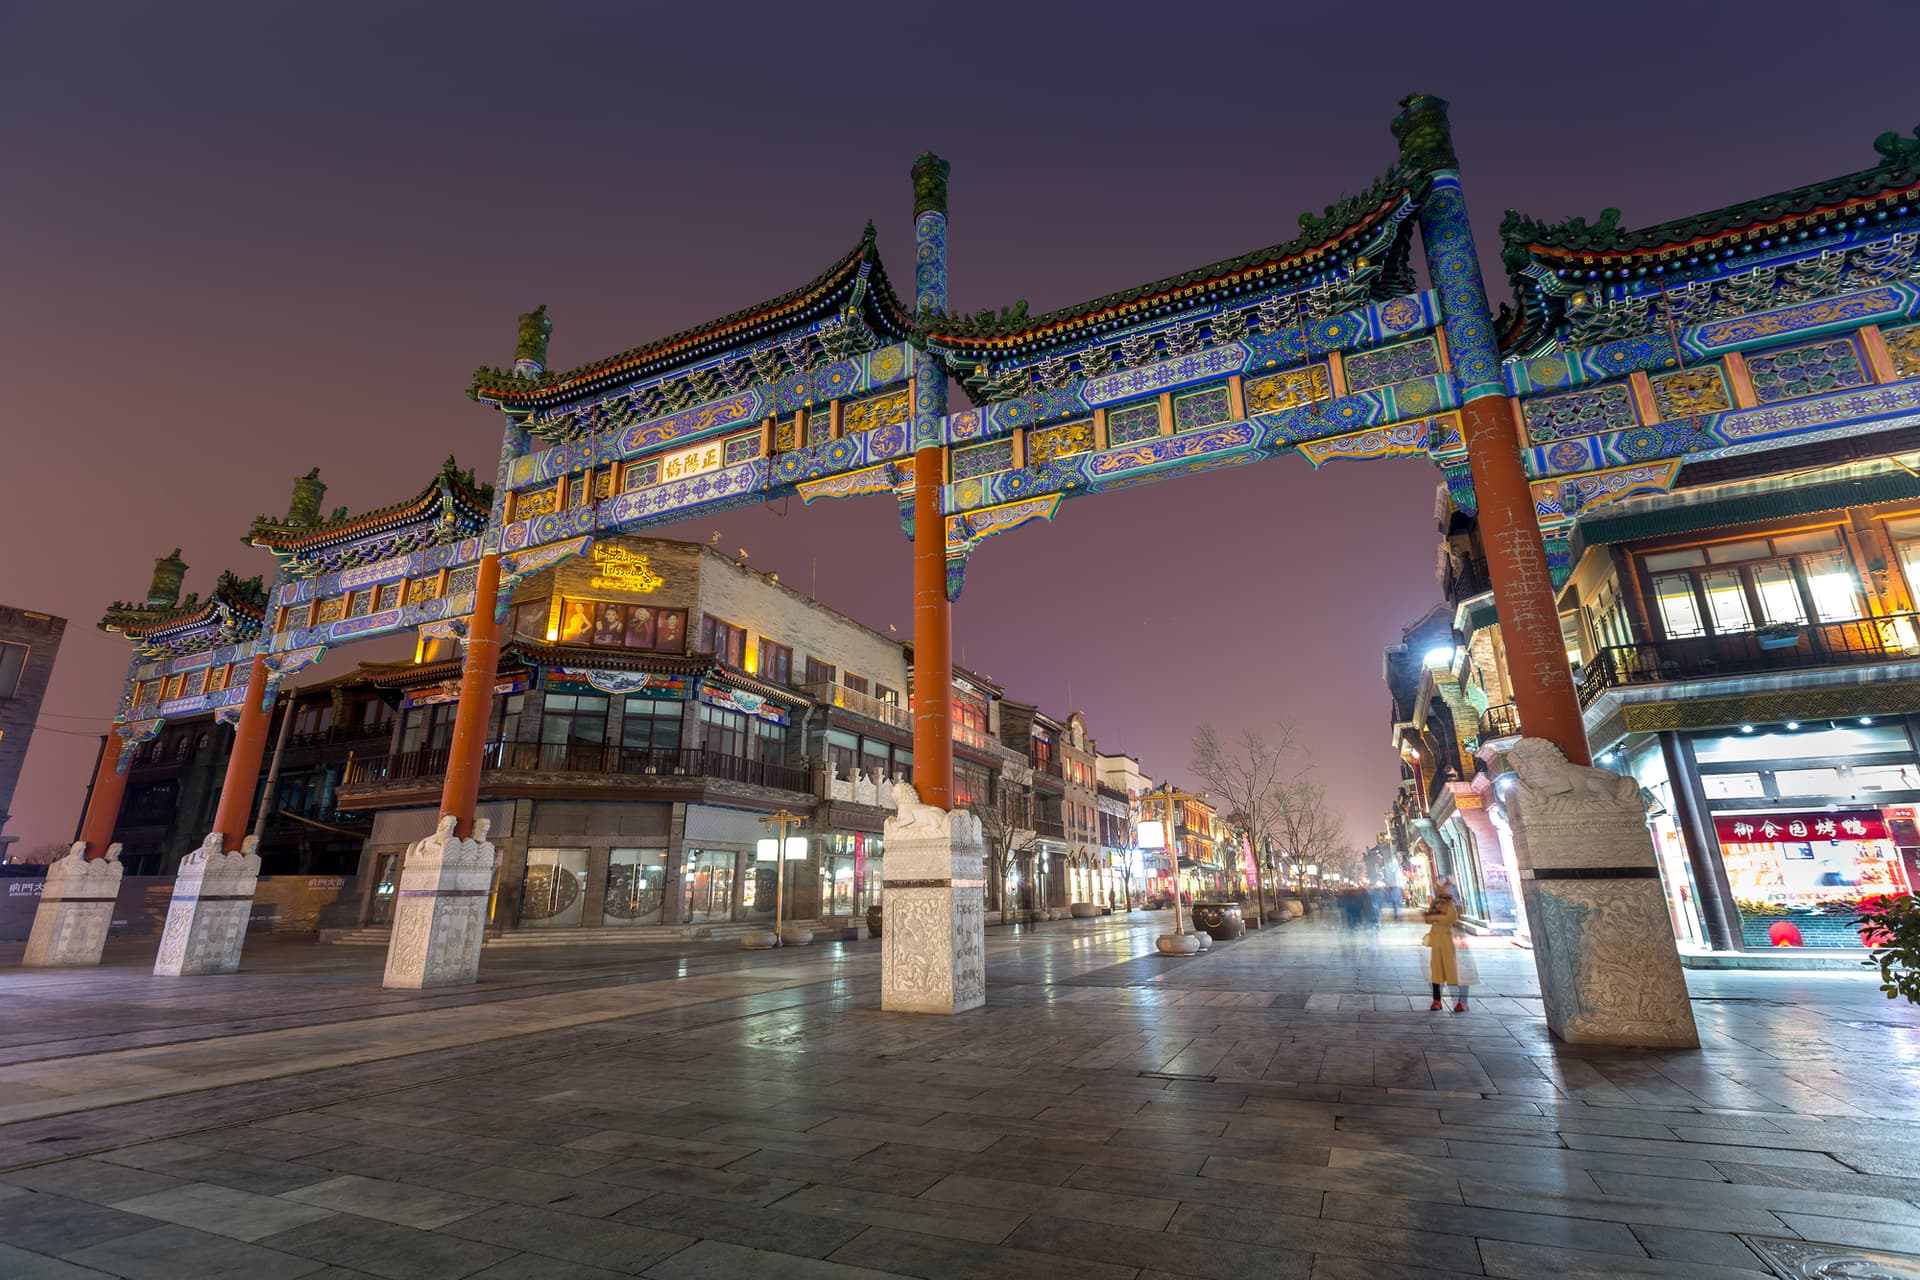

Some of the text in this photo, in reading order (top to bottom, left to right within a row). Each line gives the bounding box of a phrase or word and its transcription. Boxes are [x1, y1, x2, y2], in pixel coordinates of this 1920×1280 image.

[595, 544, 649, 563] Madame
[8, 882, 43, 892] 前門大
